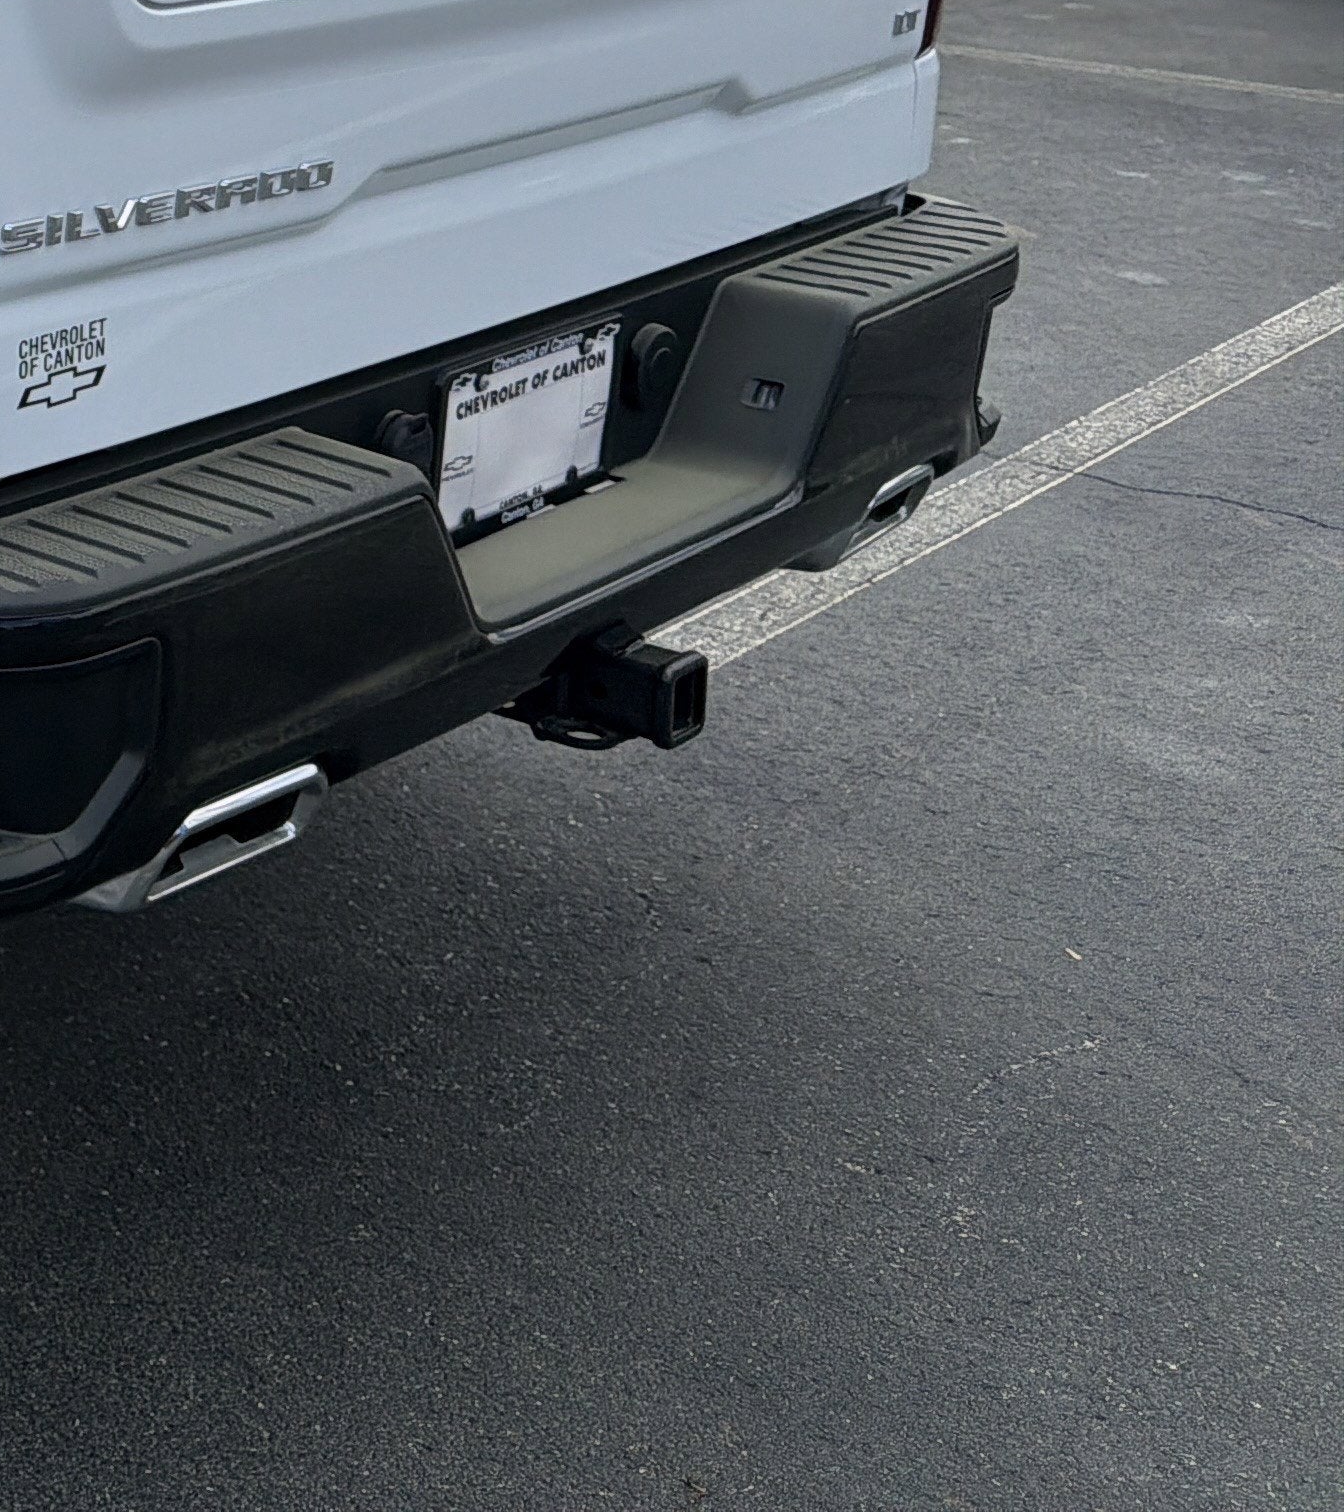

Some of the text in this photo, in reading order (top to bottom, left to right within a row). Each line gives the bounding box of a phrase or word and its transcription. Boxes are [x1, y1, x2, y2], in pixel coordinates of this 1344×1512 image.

[0, 159, 335, 255] SILVERADO
[18, 317, 107, 360] CHEVROLET
[18, 338, 106, 379] OF CANTON
[455, 349, 607, 421] CHEVROLET OF CANTON
